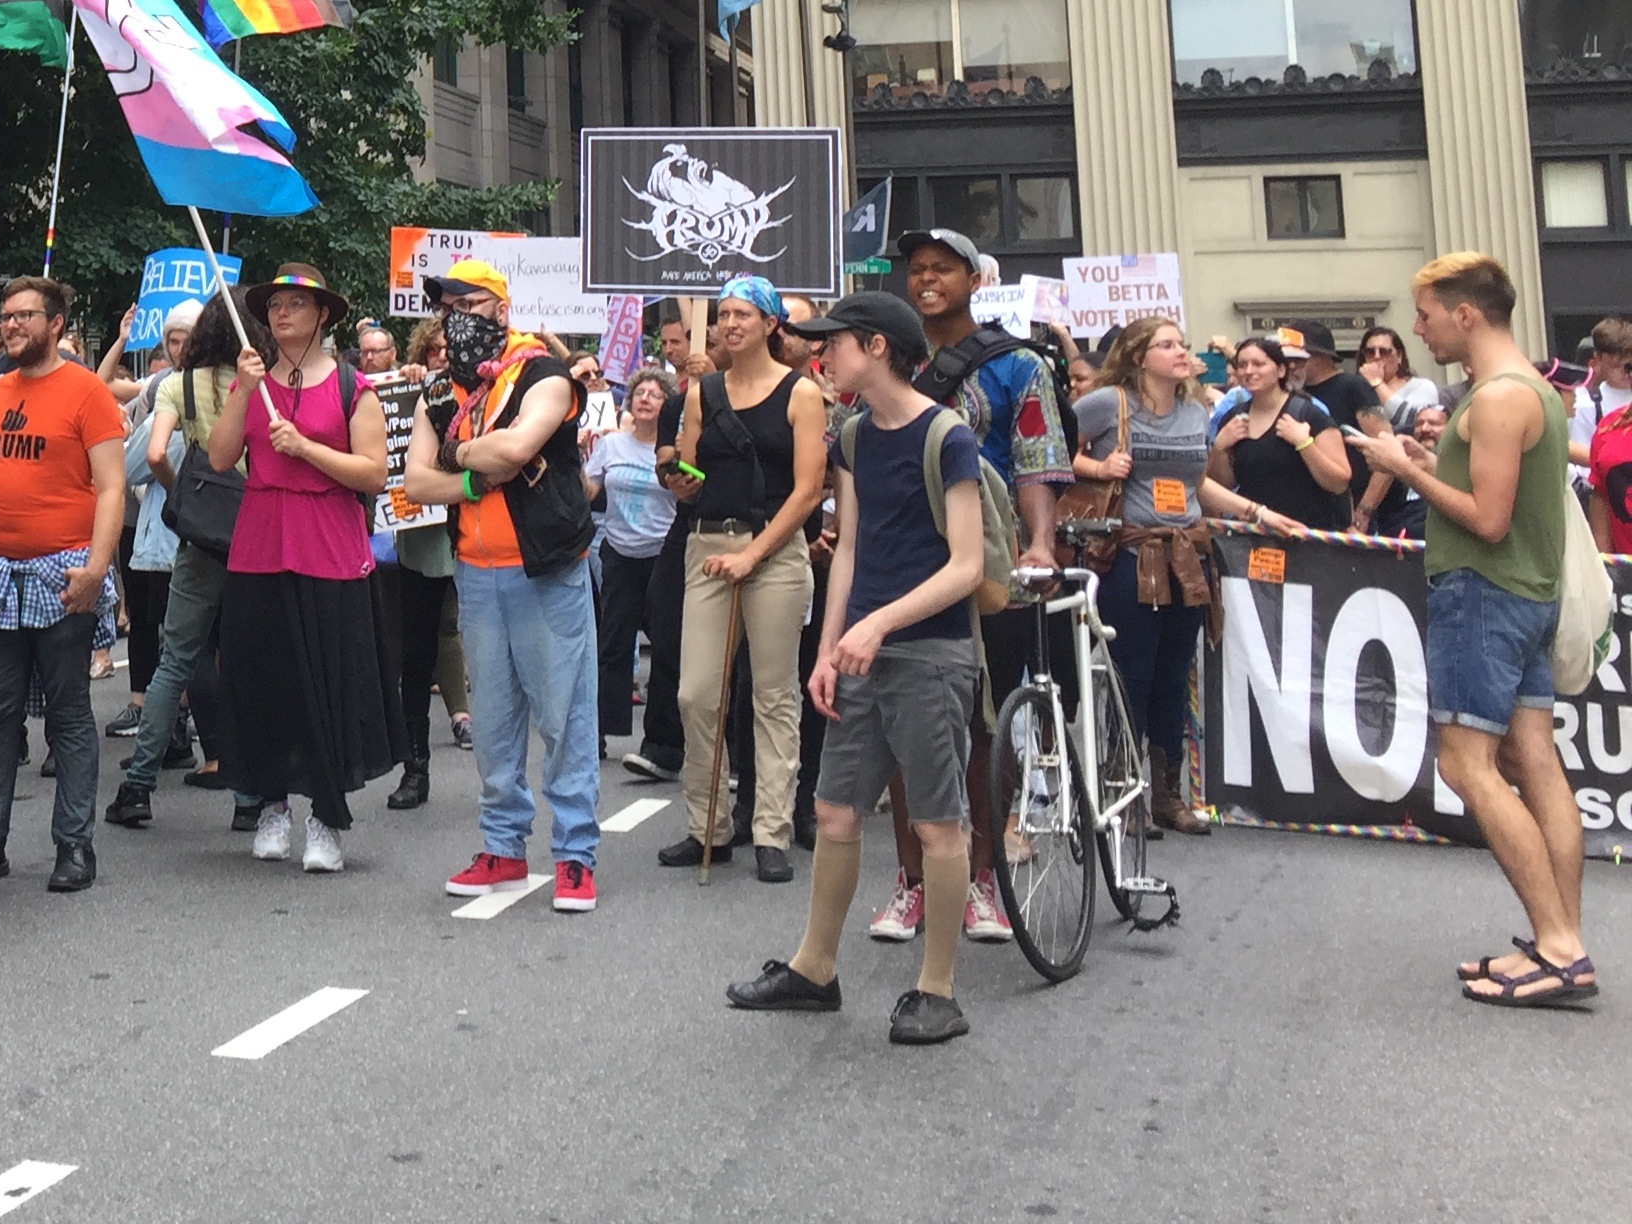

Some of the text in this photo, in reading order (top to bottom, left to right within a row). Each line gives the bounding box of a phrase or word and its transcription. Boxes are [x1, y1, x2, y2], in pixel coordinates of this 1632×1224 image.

[411, 253, 429, 268] IS
[139, 257, 238, 298] BELIEVE
[1077, 265, 1120, 284] YOU
[1108, 282, 1170, 302] BETTA
[1072, 309, 1120, 328] VOTE
[1221, 576, 1464, 815] NO
